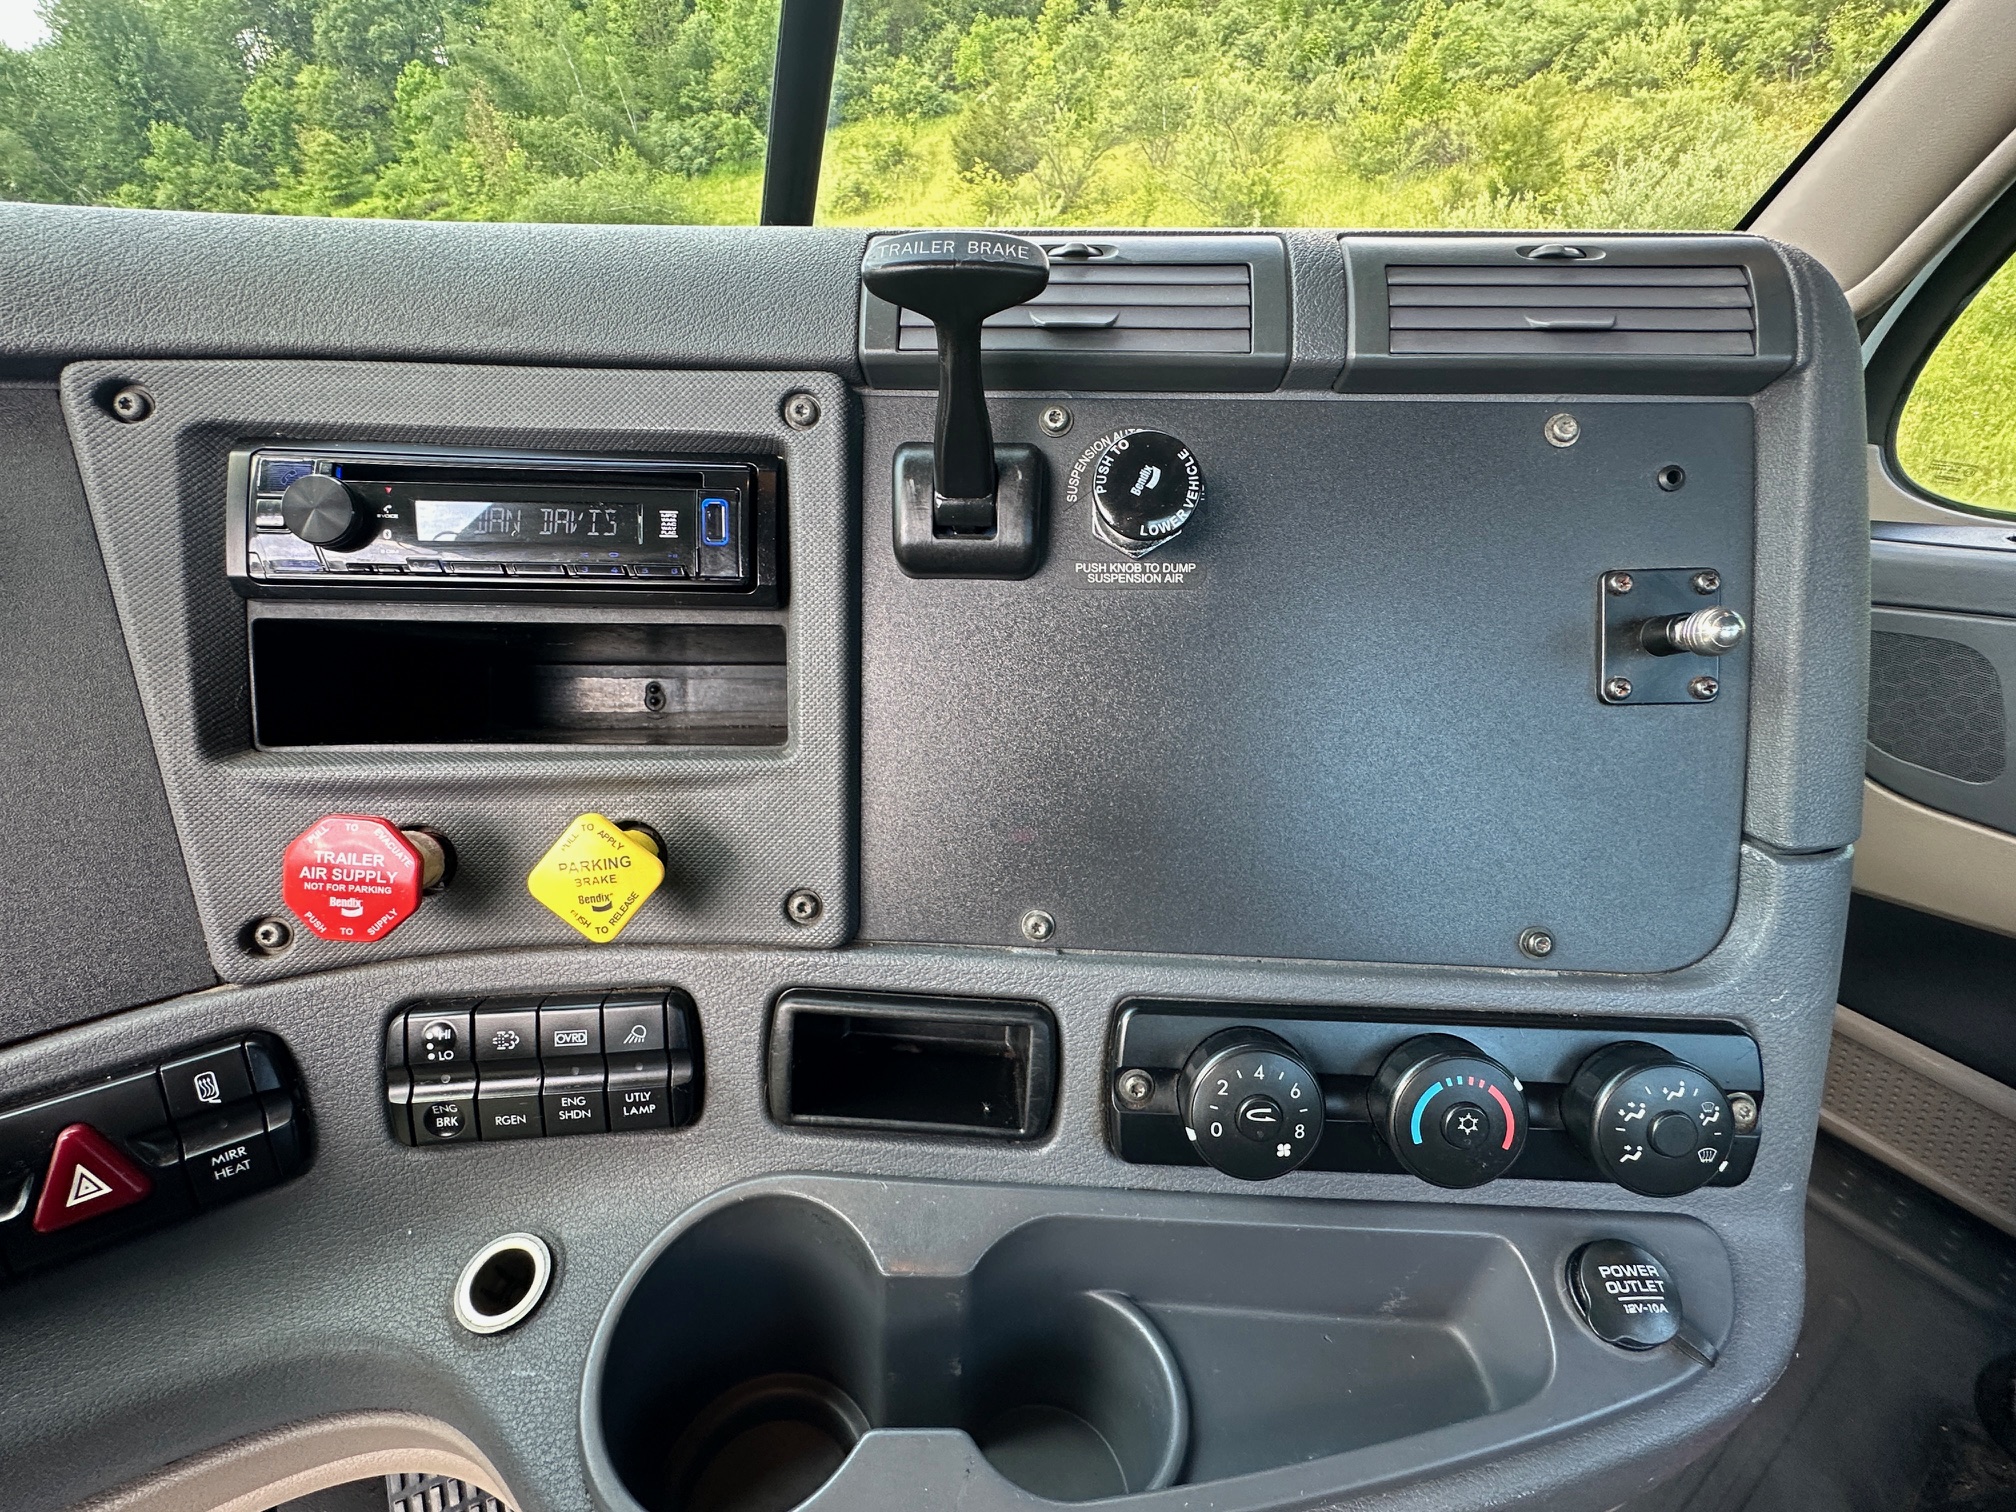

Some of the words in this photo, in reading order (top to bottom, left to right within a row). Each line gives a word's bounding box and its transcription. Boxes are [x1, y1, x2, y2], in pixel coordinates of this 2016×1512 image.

[878, 240, 955, 259] TRAILER
[967, 241, 1029, 260] BRAKE
[1066, 436, 1112, 503] SUSPENSION
[1113, 428, 1146, 442] AUT
[1096, 455, 1115, 494] PUSH
[1110, 439, 1130, 455] TO
[1130, 464, 1153, 497] Bendix
[1139, 508, 1190, 537] LOWER
[1177, 448, 1200, 509] VEHICLE
[539, 508, 617, 536] DAVIS
[1075, 563, 1107, 573] PUSH
[1109, 563, 1142, 573] KNOB
[1144, 563, 1160, 573] TO
[1162, 563, 1197, 573] DUMP
[1087, 573, 1162, 584] SUSPENSION
[1164, 573, 1184, 584] AIR
[581, 823, 595, 832] TO
[597, 829, 625, 851] APPLY
[306, 825, 330, 845] PULL
[344, 823, 359, 832] TO
[373, 827, 414, 868] EVACUATE
[314, 850, 385, 867] TRAILER
[558, 855, 632, 874] PARKING
[299, 866, 328, 880] AIR
[331, 867, 399, 884] SUPPLY
[304, 882, 325, 891] NOT
[326, 883, 346, 892] FOR
[348, 884, 392, 895] PARKING
[329, 896, 362, 909] Bendix
[578, 893, 611, 905] Bendix
[595, 925, 609, 935] TO
[609, 891, 640, 927] RELEASE
[304, 911, 327, 934] PUSH
[339, 927, 354, 936] TO
[367, 908, 399, 936] SUPPLY
[438, 1029, 451, 1040] HI
[555, 1033, 587, 1045] OVRD
[438, 1050, 454, 1061] LO
[1253, 1064, 1265, 1080] 4
[1217, 1079, 1229, 1096] 2
[1290, 1083, 1301, 1099] 6
[561, 1096, 587, 1107] ENG
[625, 1091, 652, 1103] UTLY
[432, 1104, 458, 1115] ENG
[559, 1109, 592, 1120] SHDN
[623, 1104, 656, 1116] LAMP
[436, 1116, 459, 1127] BRK
[495, 1114, 527, 1126] RGEN
[1210, 1122, 1223, 1138] 0
[1294, 1124, 1305, 1139] 8
[211, 1145, 248, 1167] MIRR
[214, 1159, 251, 1180] HEAT
[1598, 1264, 1660, 1278] POWER
[1605, 1280, 1665, 1294] OUTLET
